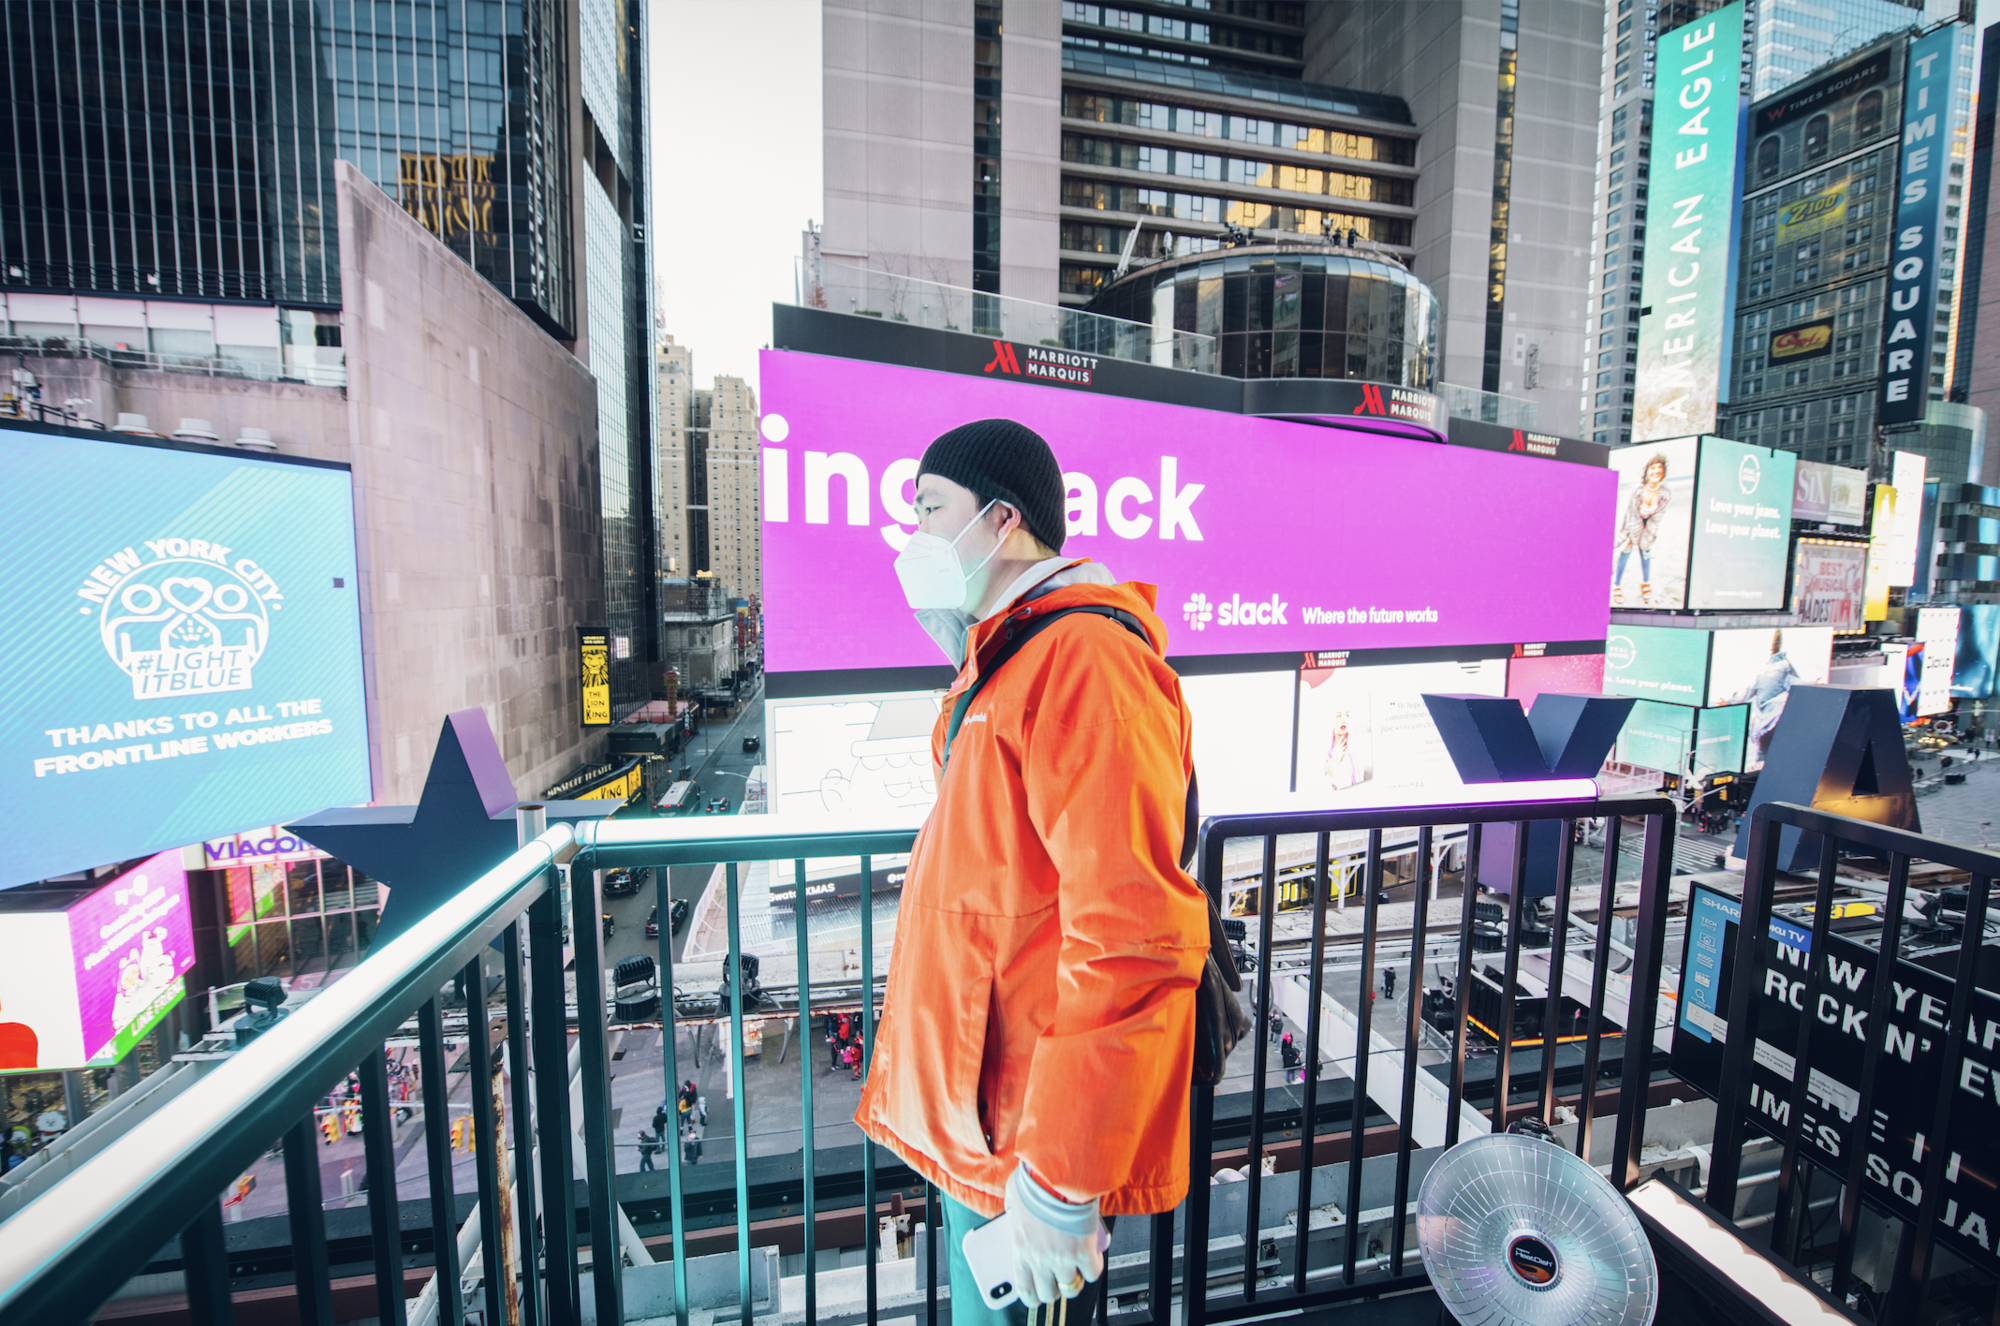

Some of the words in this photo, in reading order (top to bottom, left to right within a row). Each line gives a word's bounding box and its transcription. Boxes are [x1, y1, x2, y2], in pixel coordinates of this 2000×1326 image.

[1676, 21, 1716, 170] EAGLE
[1767, 104, 1787, 122] W
[1789, 90, 1824, 112] TIMES
[1827, 64, 1878, 93] SQUARE
[1903, 52, 1939, 205] TIMES
[1786, 193, 1839, 227] Z100
[1658, 193, 1704, 420] AMERICAN
[1886, 226, 1924, 403] SQUARE
[1028, 348, 1098, 369] MARRIOTT
[1028, 362, 1090, 383] MARQUIS
[1391, 389, 1436, 409] MARRIOTT
[1391, 403, 1432, 421] MARQUIS
[1527, 433, 1561, 446] MARRIOTT
[1527, 443, 1556, 456] MARQUIS
[1710, 497, 1729, 514] Love
[1729, 504, 1755, 519] your
[1755, 504, 1781, 519] jeans.
[1705, 519, 1728, 535] Love
[1728, 523, 1751, 538] your
[1751, 523, 1782, 540] planet.
[77, 546, 142, 604] NEW
[143, 537, 233, 566] YORK
[235, 558, 284, 601] CITY
[1820, 561, 1843, 576] BEST
[1810, 577, 1848, 593] MUSICAL
[1217, 593, 1288, 626] slack
[1302, 606, 1345, 625] Where
[1346, 606, 1367, 625] the
[1368, 606, 1404, 625] future
[1405, 606, 1438, 623] works
[137, 649, 242, 674] #LIGHT
[1317, 658, 1346, 667] MARQUIS
[1318, 651, 1350, 660] MARRIOTT
[140, 667, 241, 694] ITBLUE
[1616, 675, 1637, 686] Love
[1637, 679, 1659, 688] your
[1660, 681, 1696, 693] planet.
[586, 698, 605, 709] LION
[45, 716, 175, 748] THANKS
[179, 711, 218, 731] TO
[225, 705, 273, 726] ALL
[276, 699, 322, 719] THE
[586, 709, 608, 721] KING
[1628, 729, 1664, 740] AMERICAN
[34, 736, 209, 778] FRONTLINE
[212, 719, 333, 750] WORKERS
[601, 784, 622, 799] KING
[768, 889, 797, 903] Swatc
[806, 883, 836, 897] XMAS
[1702, 896, 1741, 918] SHAR
[1700, 916, 1718, 928] TECH
[1787, 929, 1806, 943] TV
